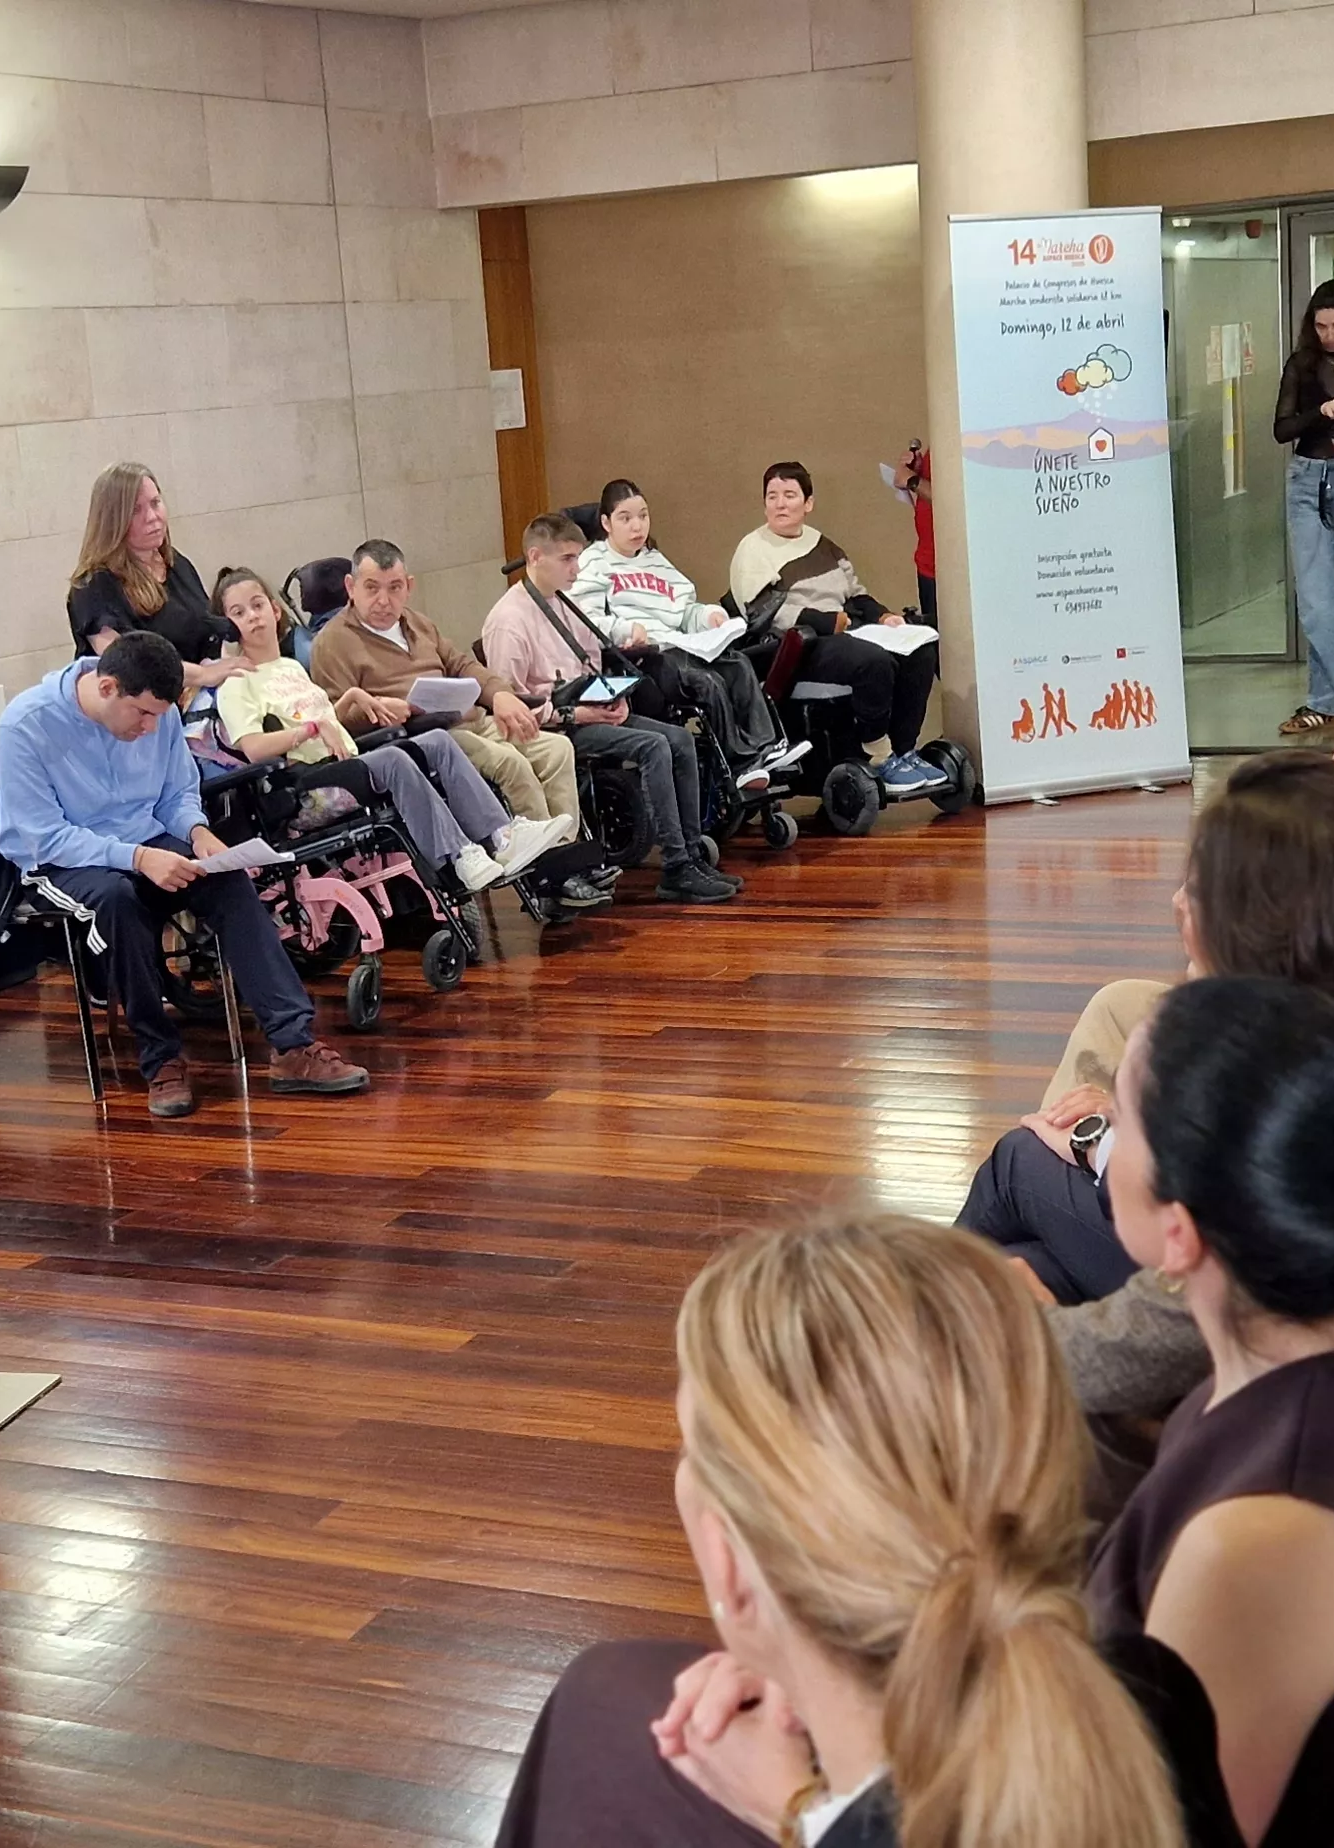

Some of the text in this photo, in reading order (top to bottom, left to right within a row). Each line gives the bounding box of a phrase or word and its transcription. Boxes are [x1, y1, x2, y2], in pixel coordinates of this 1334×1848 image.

[1007, 238, 1036, 266] 14
[1041, 236, 1085, 255] Marcha
[1005, 280, 1030, 291] Palacio
[1032, 279, 1041, 288] de
[1043, 278, 1077, 291] Congresos
[1079, 276, 1088, 286] de
[999, 296, 1027, 307] Marcha
[1029, 293, 1064, 305] senderista
[1066, 292, 1098, 304] solidaria
[1110, 291, 1122, 300] km
[1000, 312, 1125, 340] Domingo, 12 de abril
[1034, 448, 1079, 474] ÚNETE
[1035, 471, 1111, 494] A NUESTRO
[1035, 492, 1079, 515] SUEÑO
[1037, 546, 1112, 566] Inscripción gratuita
[1037, 563, 1115, 580] Donación voluntaria
